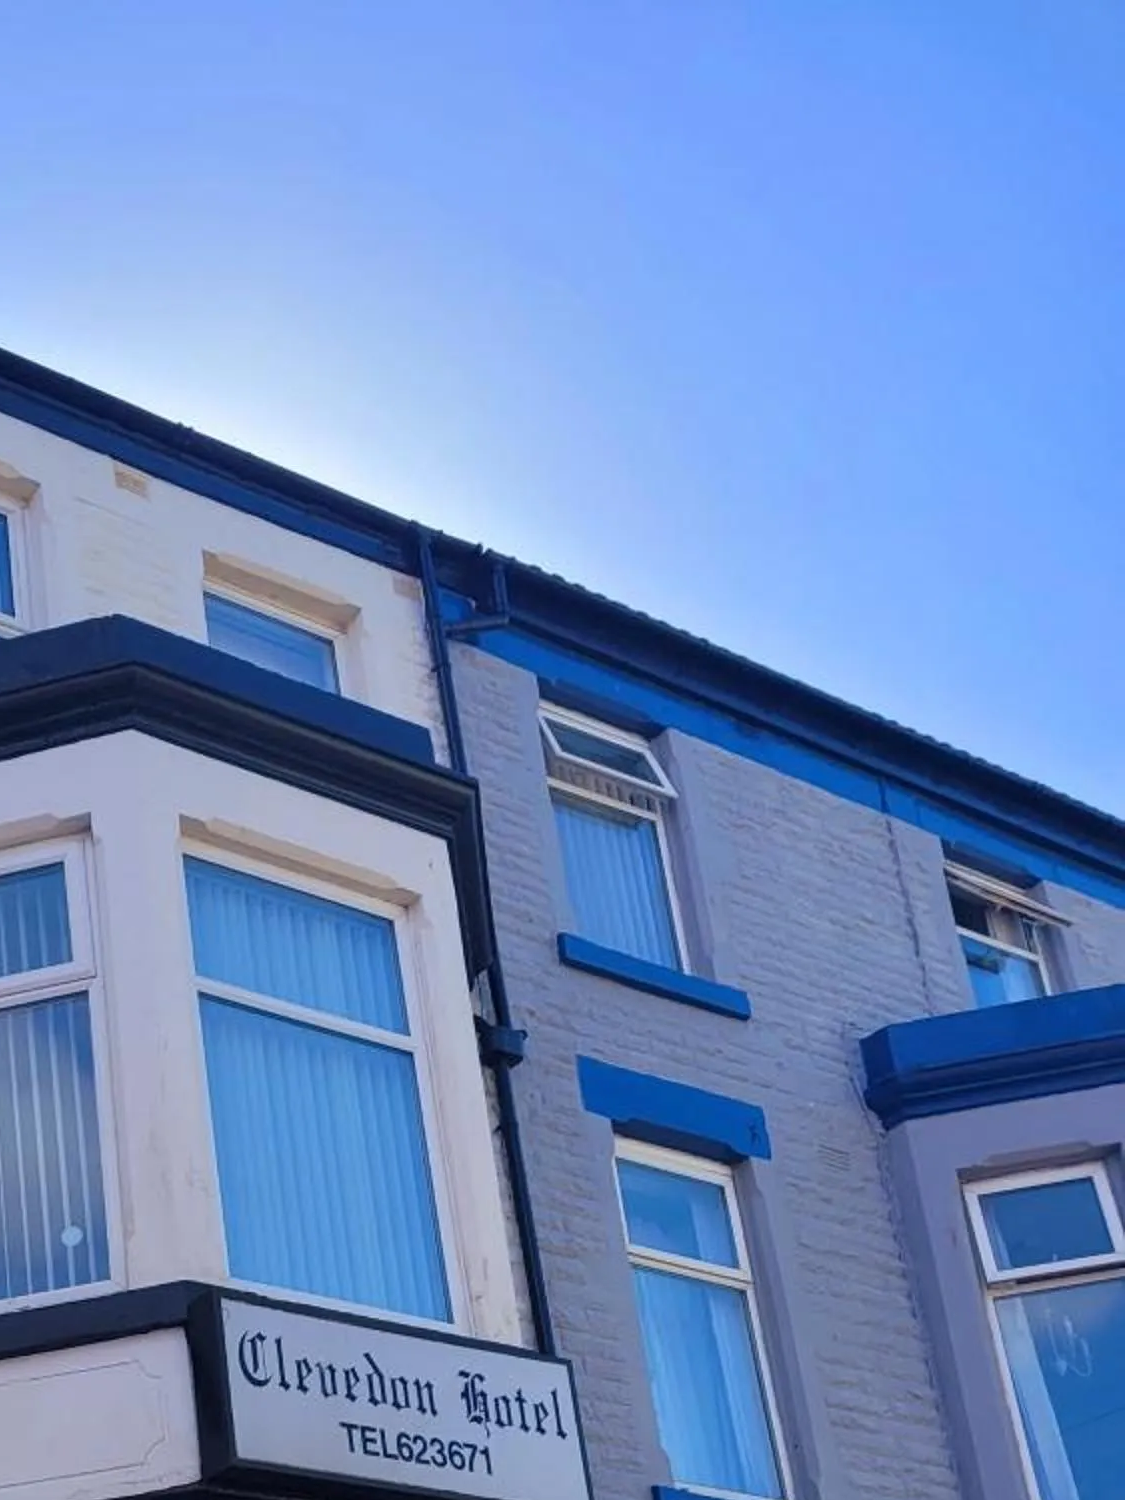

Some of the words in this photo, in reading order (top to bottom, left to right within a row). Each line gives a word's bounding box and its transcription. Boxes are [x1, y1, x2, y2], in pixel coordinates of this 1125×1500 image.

[238, 1330, 438, 1417] Clevedon
[458, 1370, 568, 1440] Hotel
[339, 1421, 493, 1475] TEL623671
